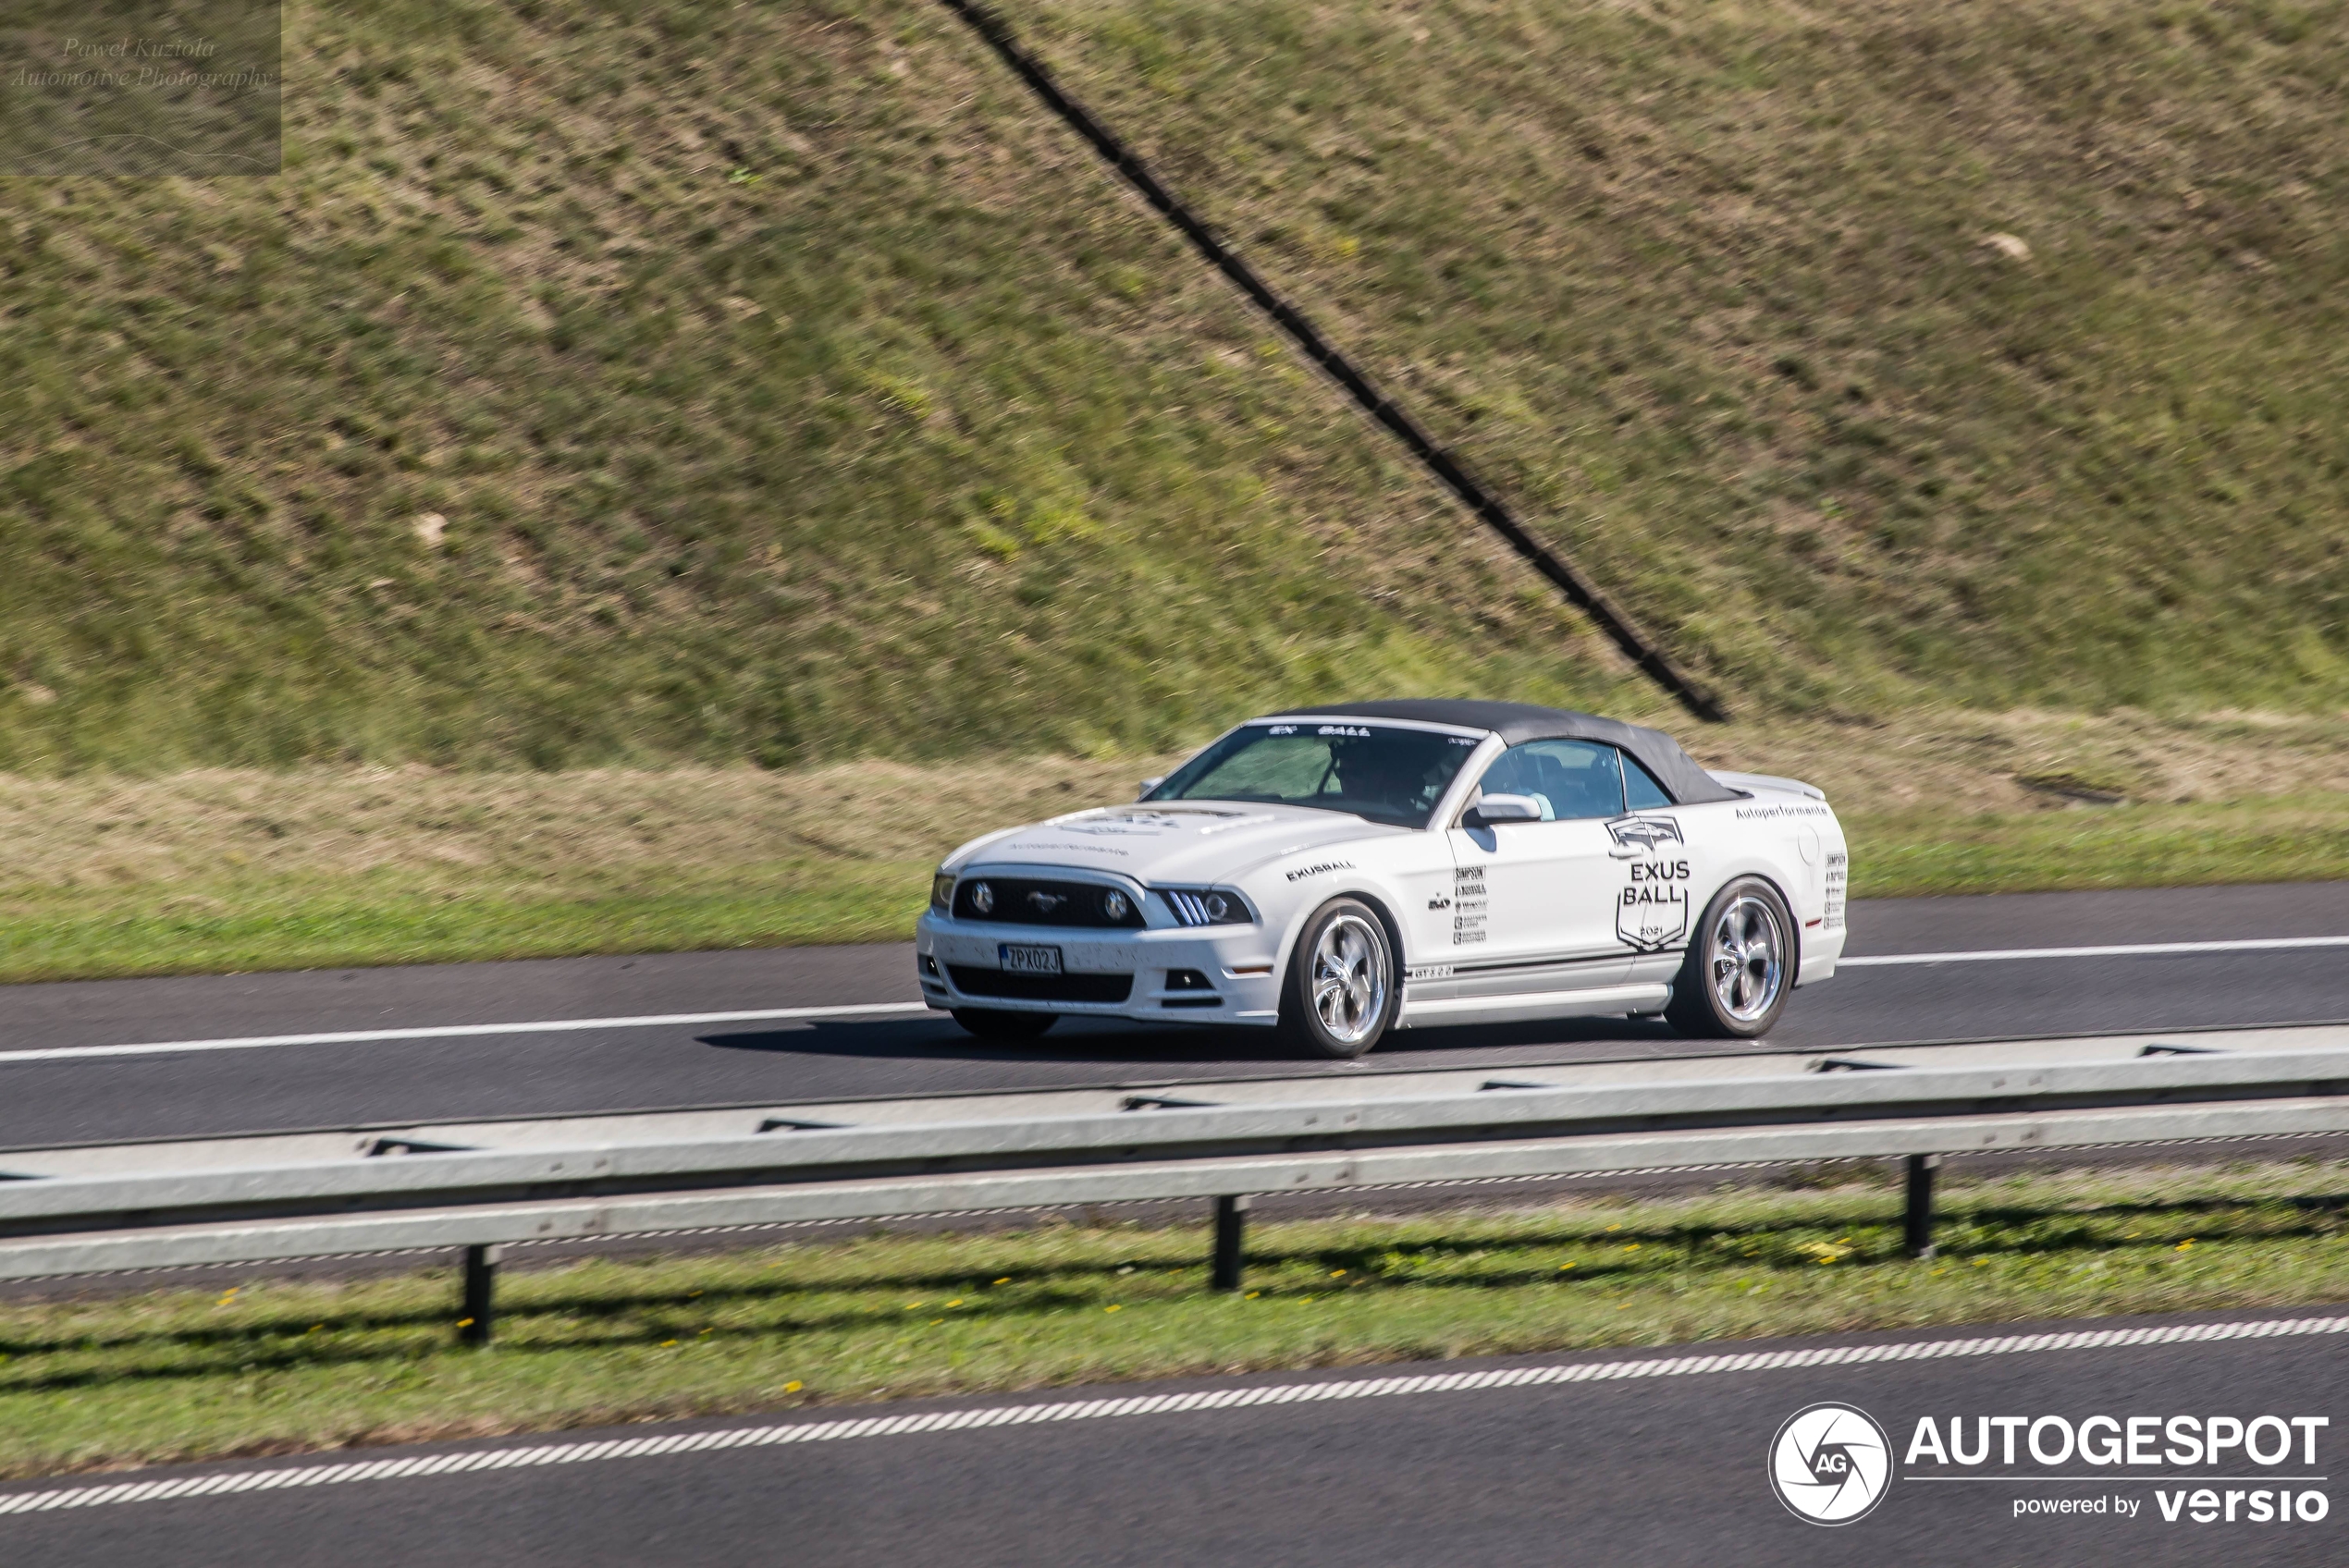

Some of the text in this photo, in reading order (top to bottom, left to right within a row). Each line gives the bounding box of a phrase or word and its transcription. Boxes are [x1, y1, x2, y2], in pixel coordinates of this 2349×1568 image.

[1736, 803, 1828, 820] Autoperformante
[1285, 860, 1357, 882] EXUSBALL
[1631, 861, 1690, 881] EXUS
[1624, 885, 1682, 905] BALL
[1641, 925, 1664, 937] 2021
